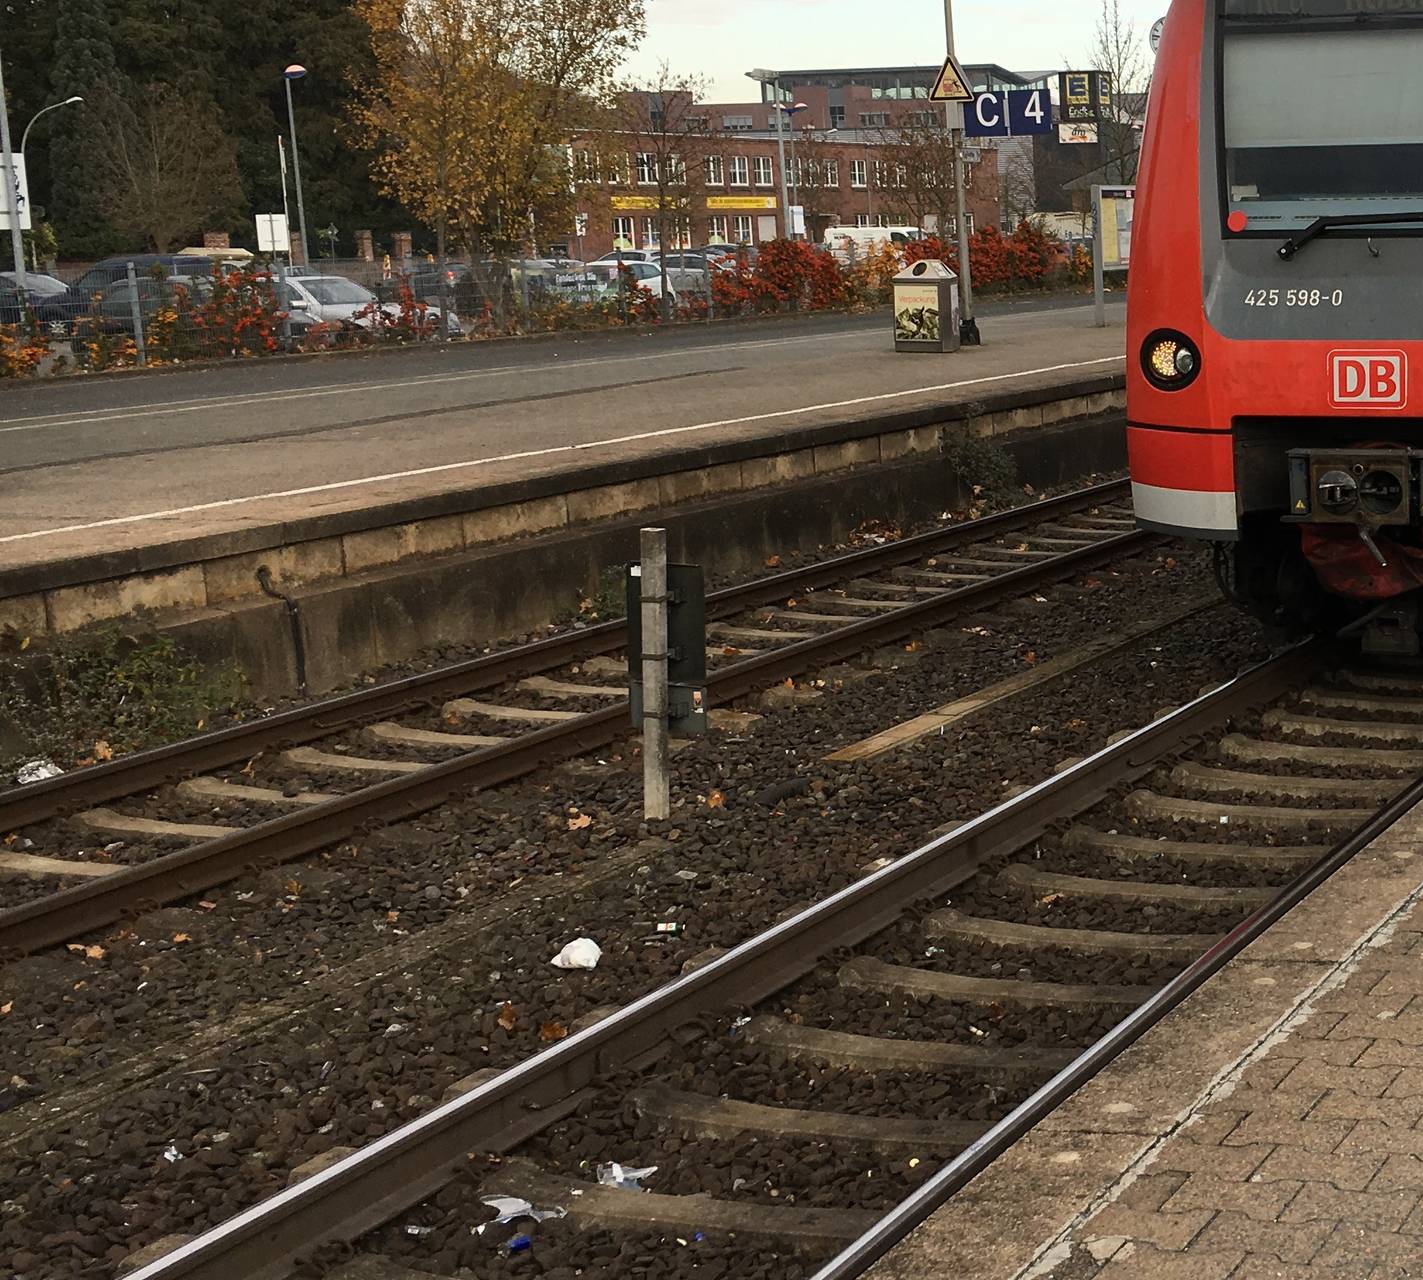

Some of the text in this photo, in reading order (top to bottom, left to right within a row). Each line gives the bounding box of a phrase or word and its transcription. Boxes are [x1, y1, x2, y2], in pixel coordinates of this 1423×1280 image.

[976, 93, 999, 127] C
[1024, 91, 1044, 124] 4
[898, 295, 935, 304] Verpackung
[1244, 289, 1343, 306] 425 598-0
[1338, 360, 1397, 398] DB
